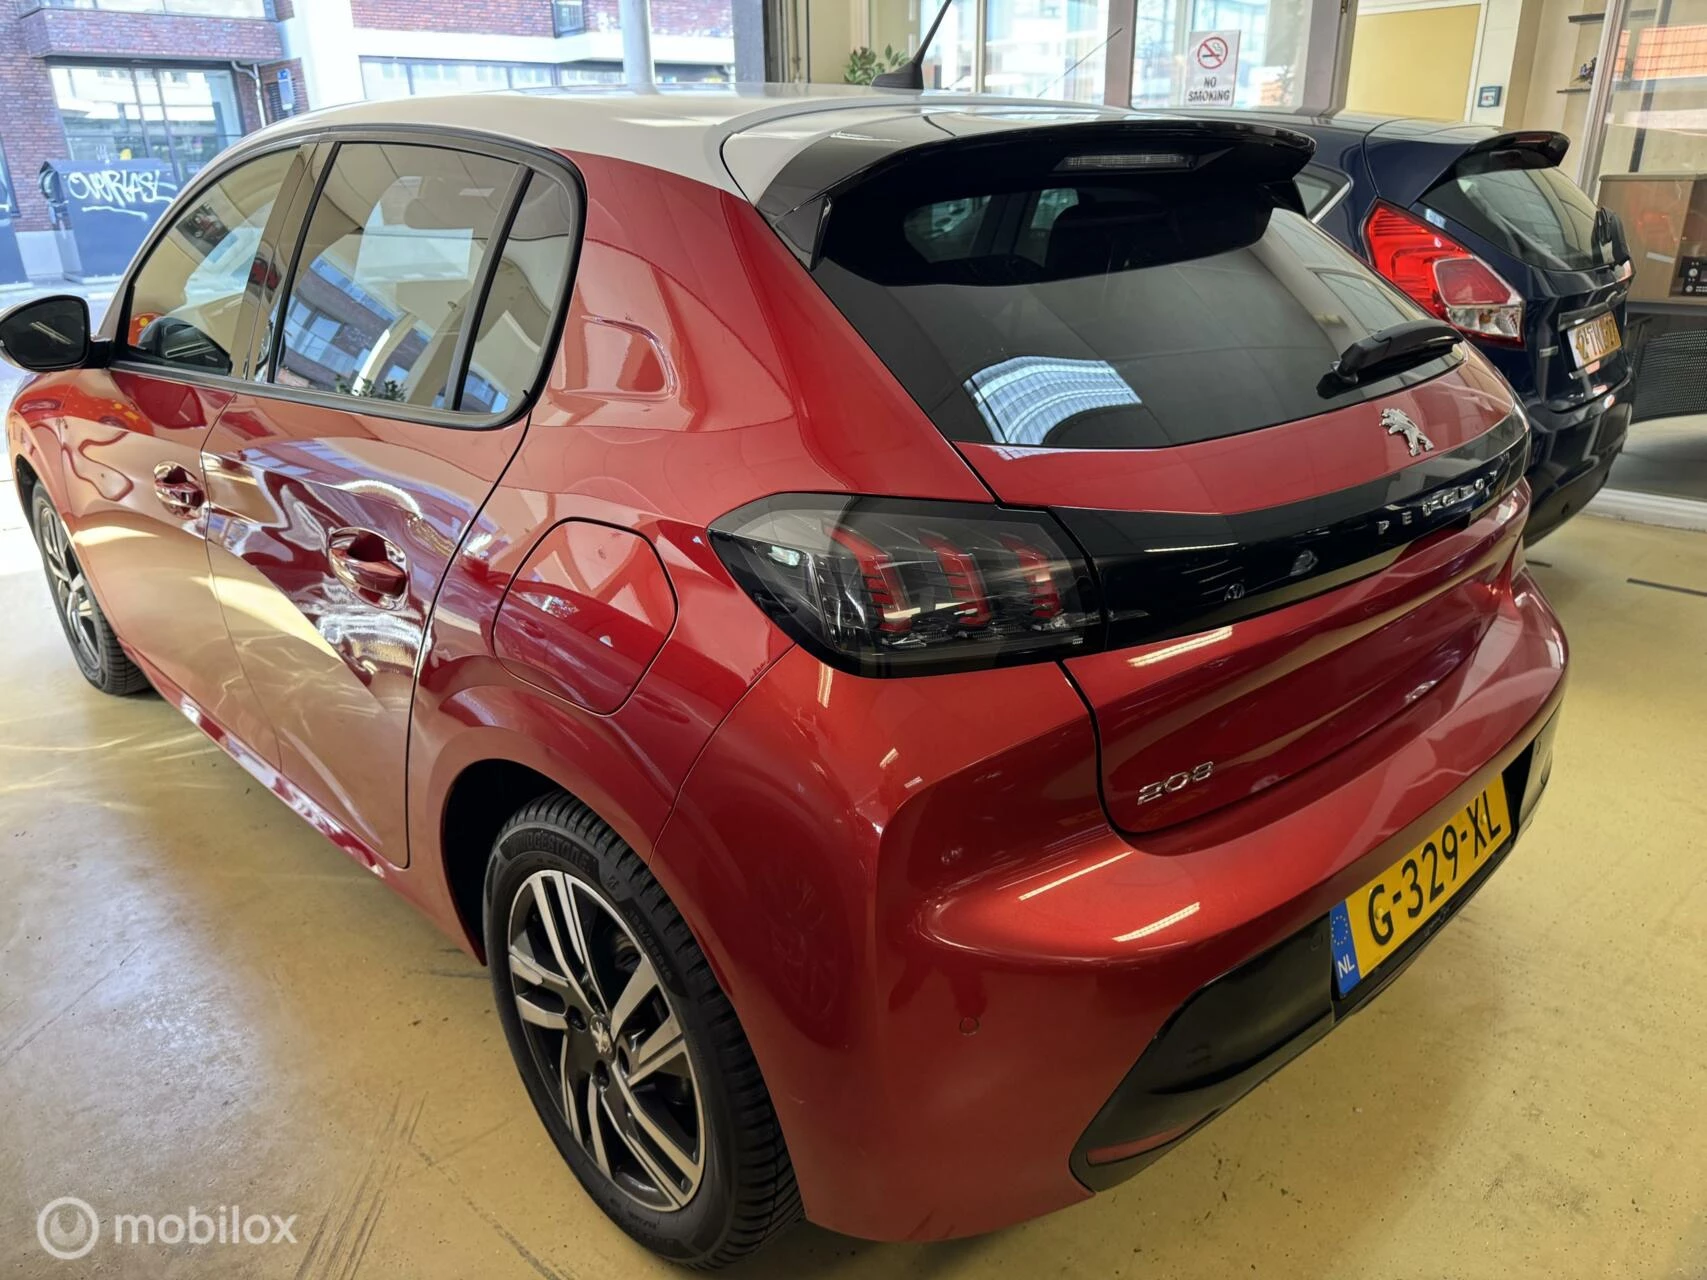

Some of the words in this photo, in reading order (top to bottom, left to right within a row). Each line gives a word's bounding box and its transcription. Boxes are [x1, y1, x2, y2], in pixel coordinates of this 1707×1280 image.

[1203, 76, 1217, 88] NO
[1187, 90, 1230, 102] SMOKING
[1137, 761, 1213, 805] 208
[1368, 791, 1501, 946] G-329-XL
[1337, 953, 1355, 979] NL
